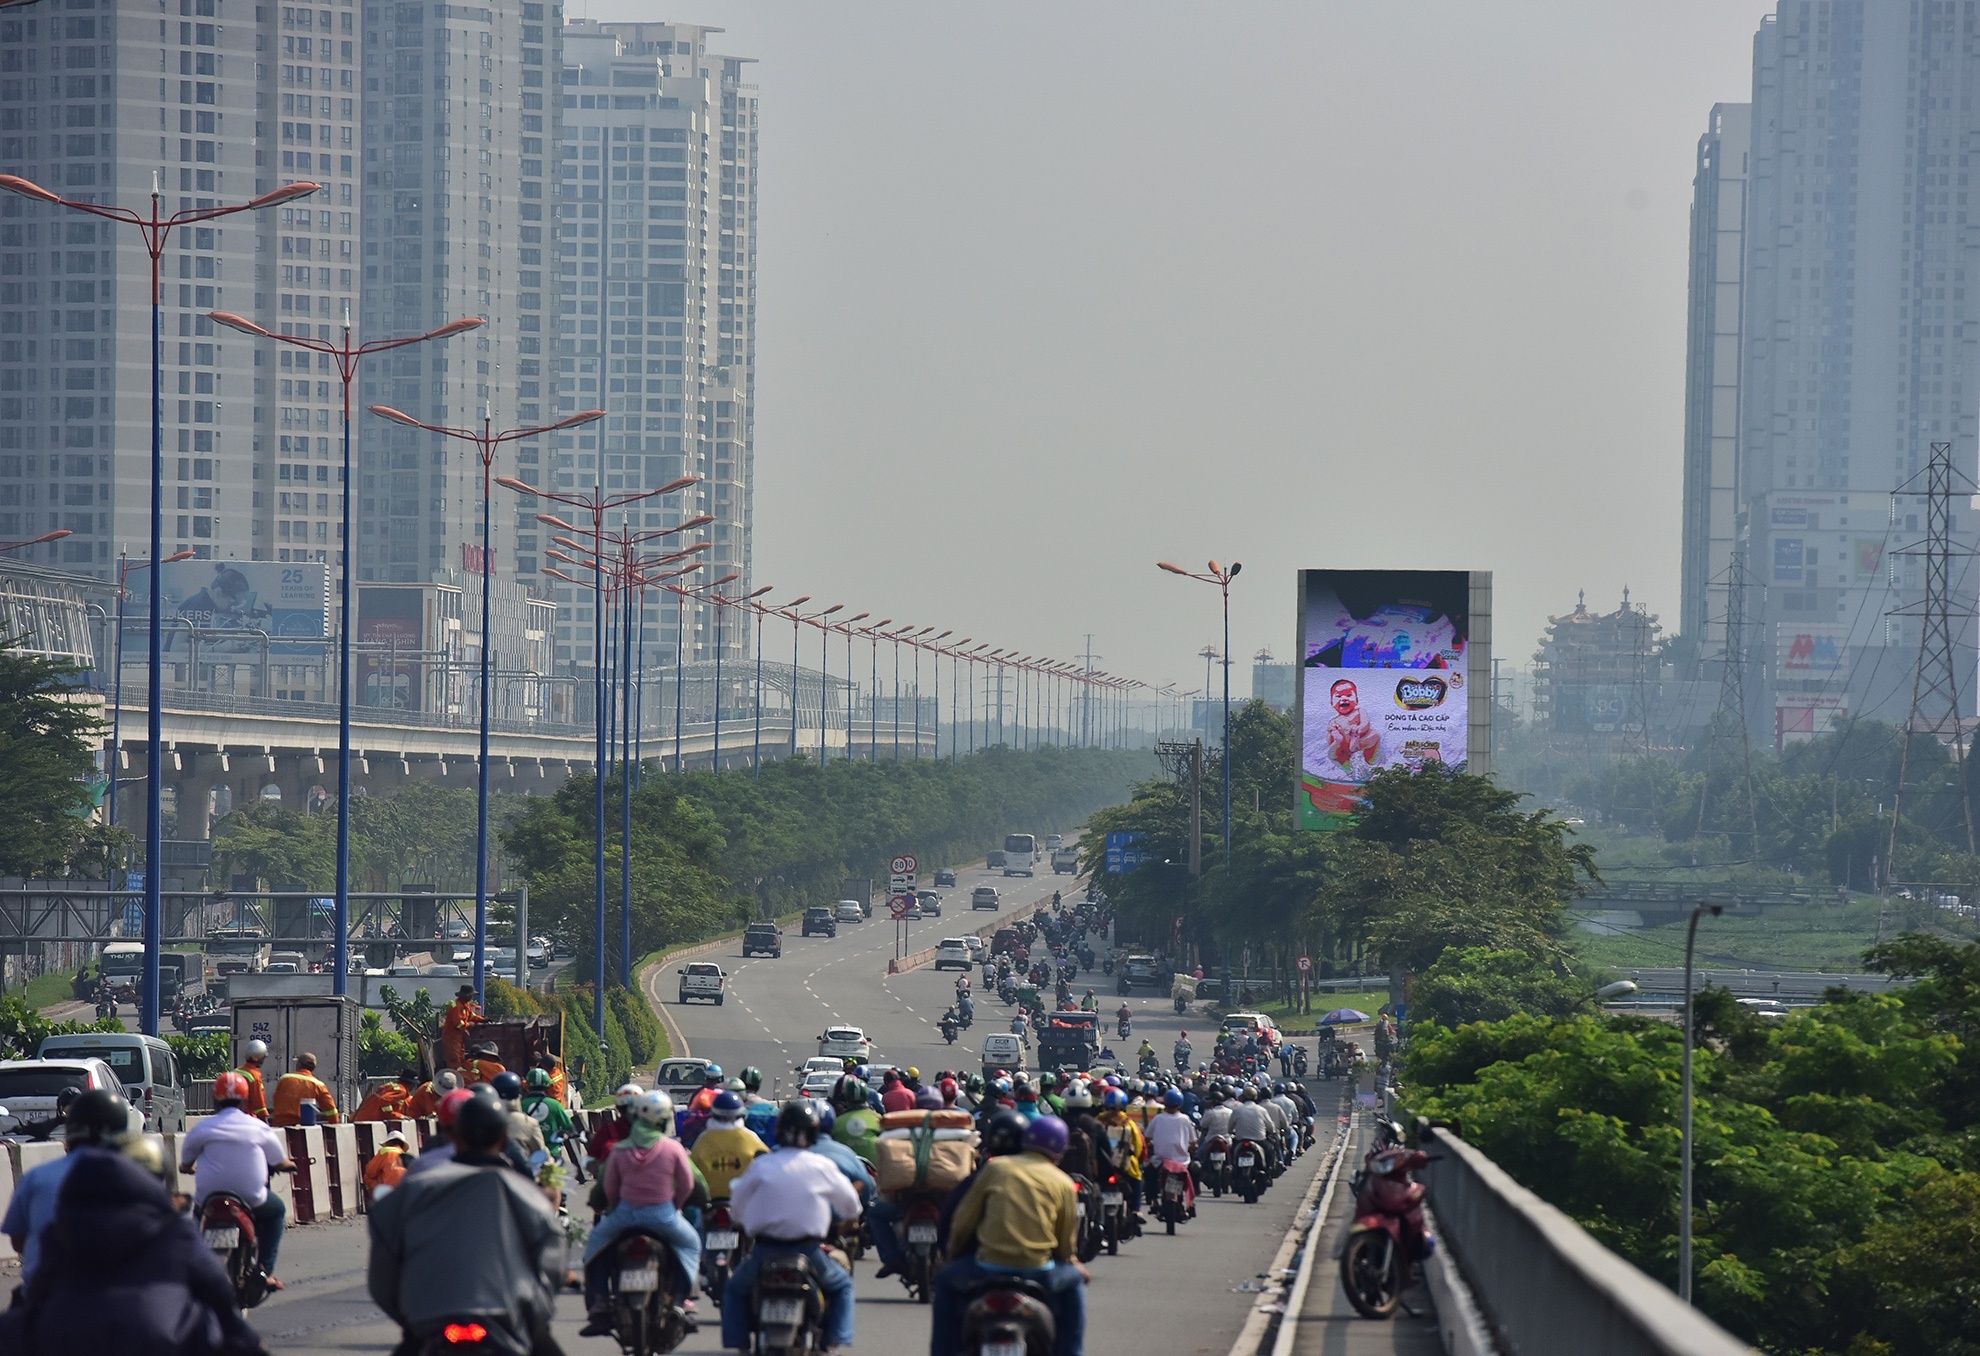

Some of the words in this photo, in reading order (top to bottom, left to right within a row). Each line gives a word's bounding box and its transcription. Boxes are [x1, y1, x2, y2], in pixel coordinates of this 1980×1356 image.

[281, 569, 304, 584] 25
[1402, 685, 1440, 698] Bobby
[252, 1022, 269, 1032] 54Z
